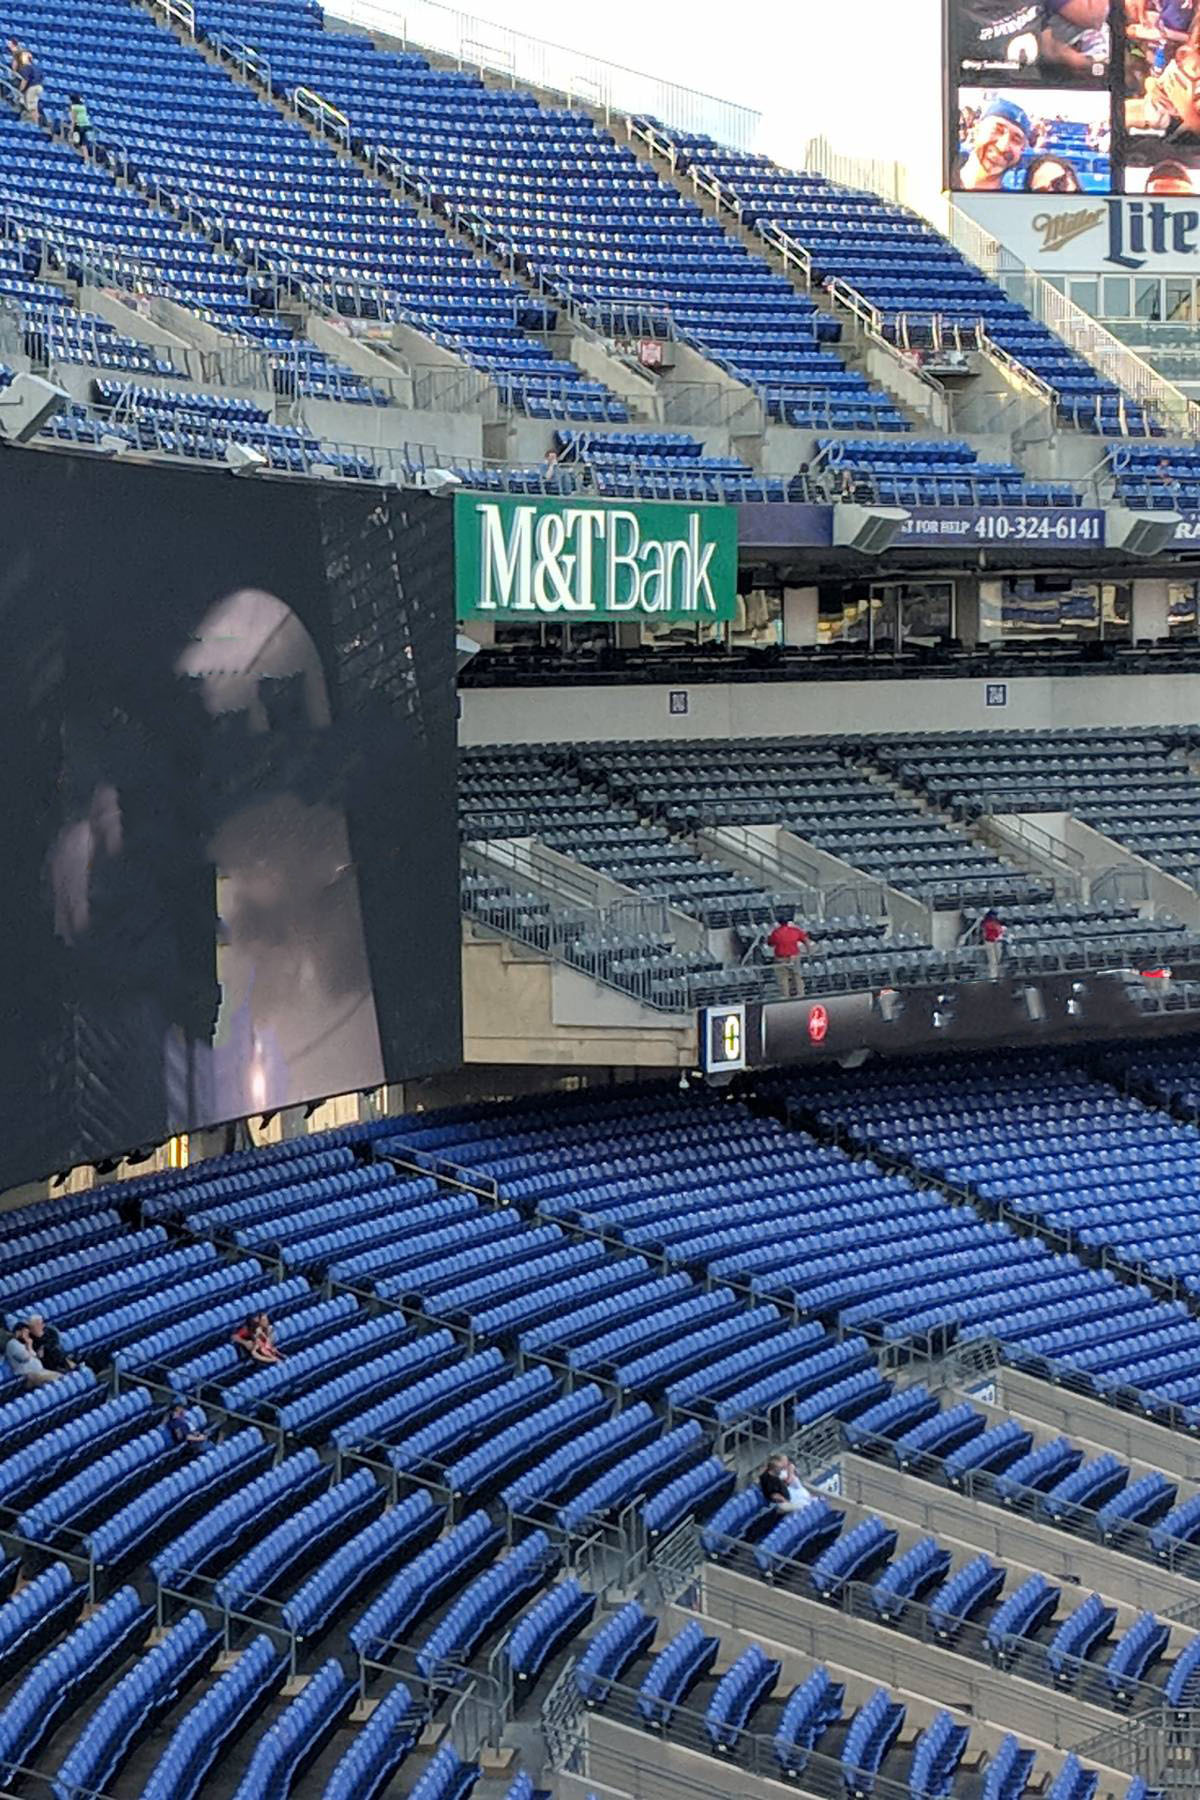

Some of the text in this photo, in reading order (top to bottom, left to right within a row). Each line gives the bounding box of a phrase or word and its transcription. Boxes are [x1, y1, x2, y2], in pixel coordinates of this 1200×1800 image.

[1032, 199, 1199, 269] Miller Lite
[475, 504, 717, 613] M&T Bank
[974, 516, 1099, 539] 410-324-6141
